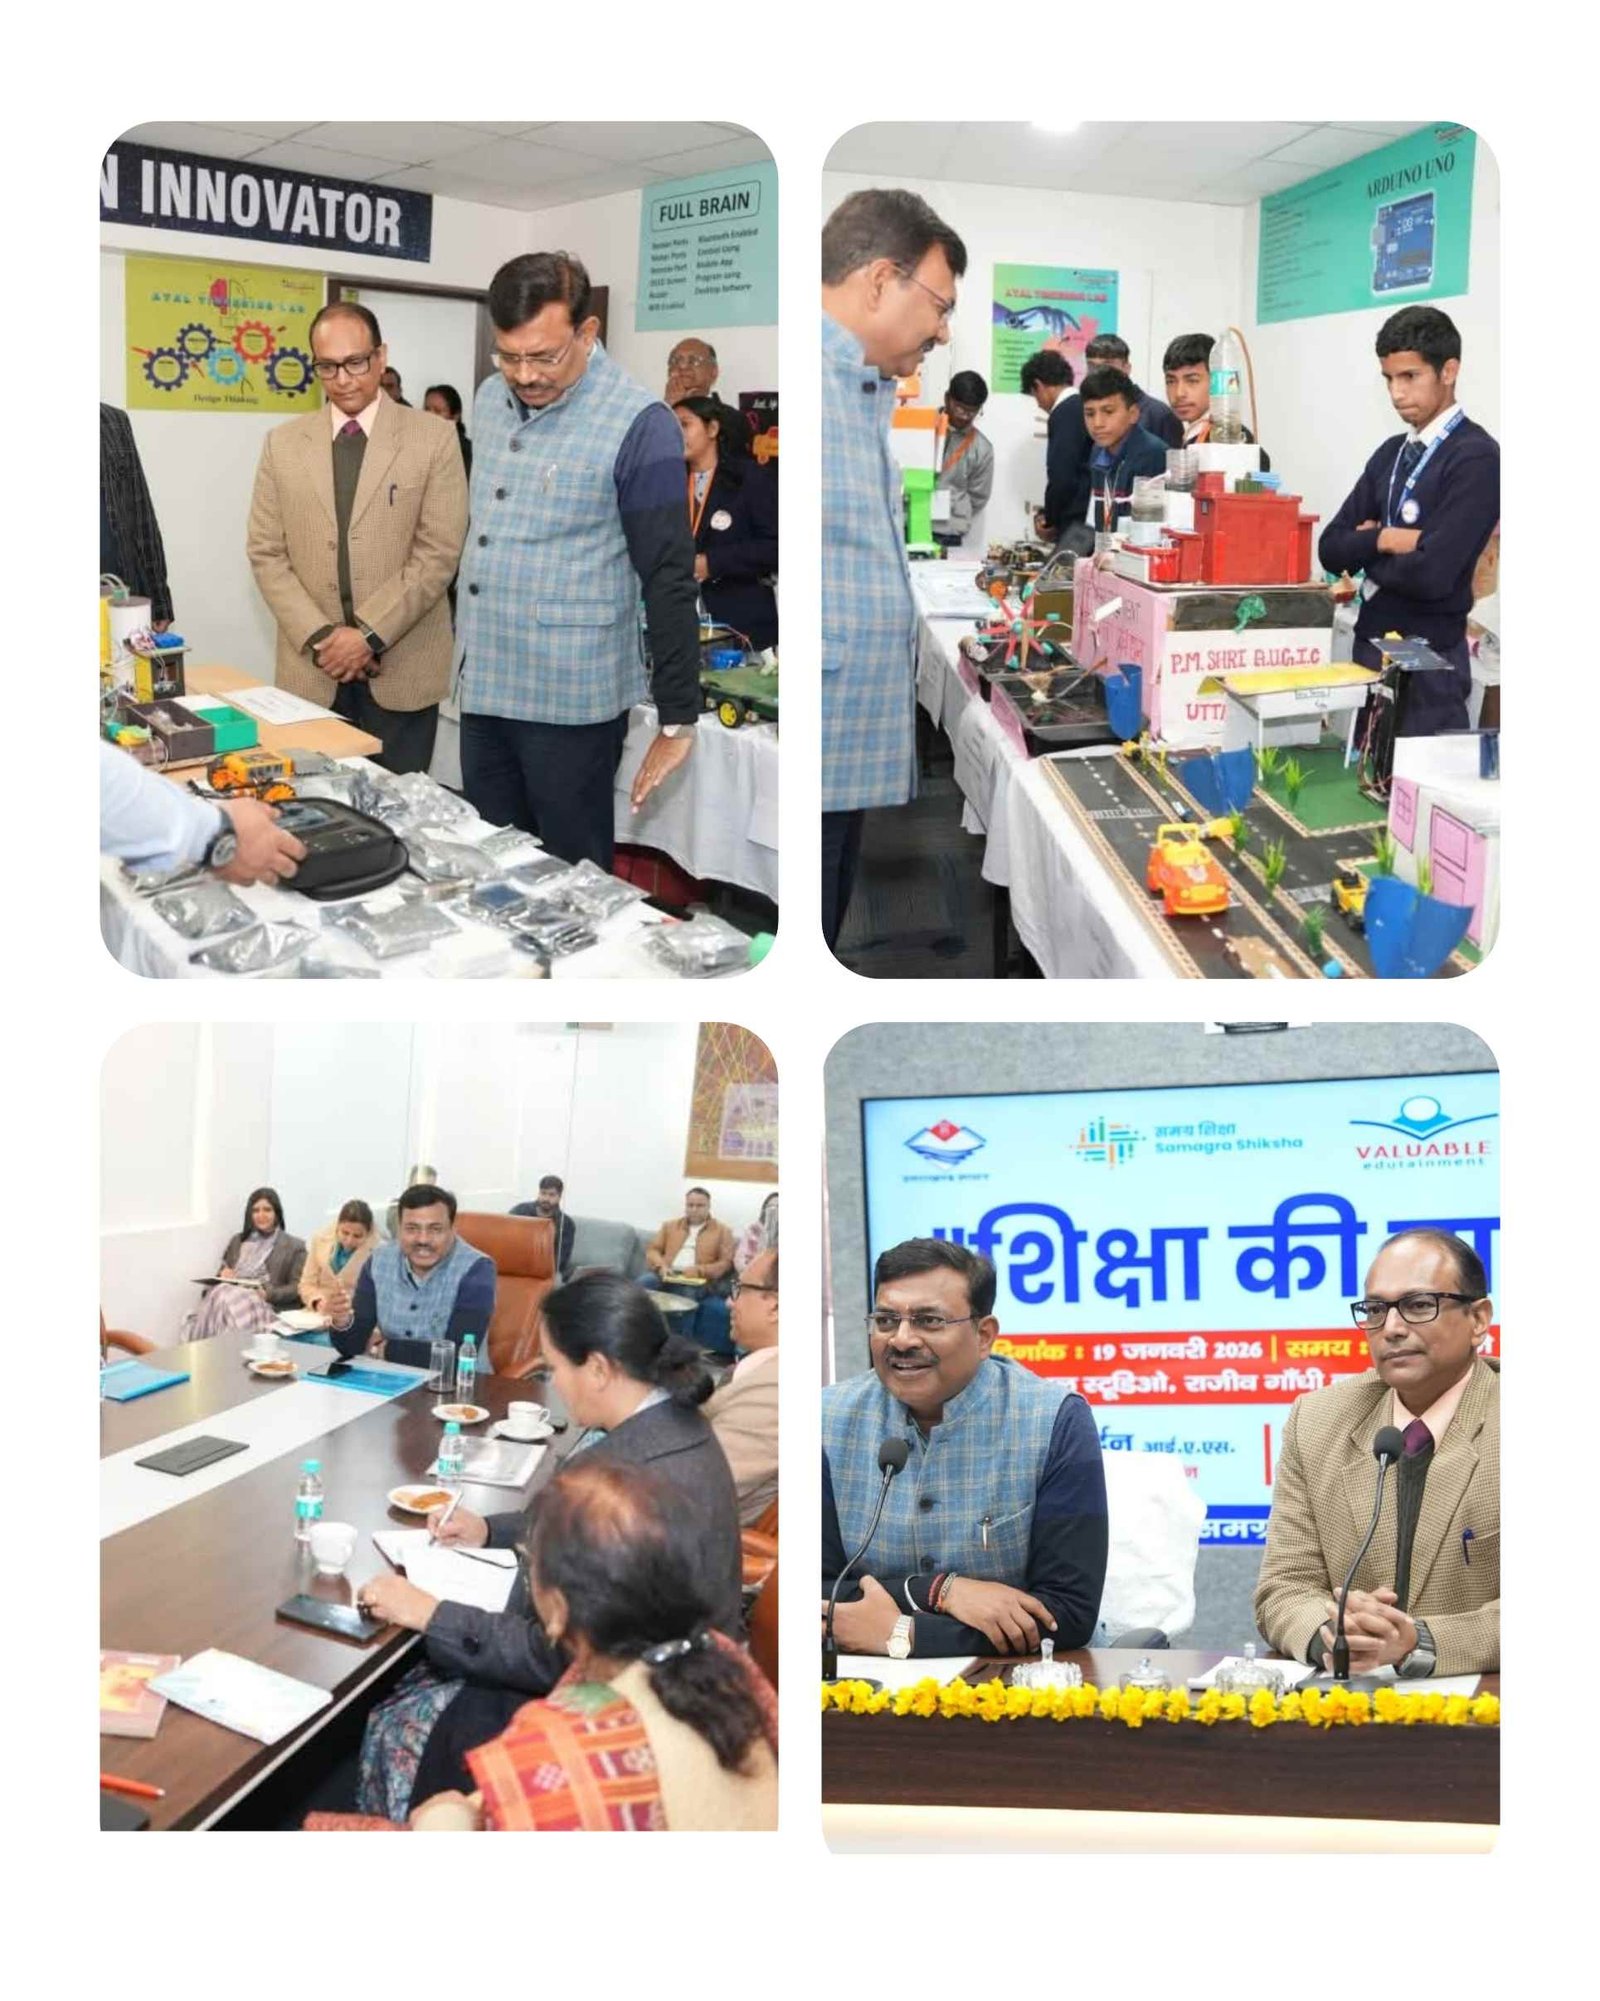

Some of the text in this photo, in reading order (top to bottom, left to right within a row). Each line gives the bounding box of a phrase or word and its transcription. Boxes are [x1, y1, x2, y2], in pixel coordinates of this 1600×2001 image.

[1365, 151, 1456, 199] ARDUINO UNO
[141, 159, 403, 248] INNOVATOR
[659, 190, 751, 223] FULL BRAIN
[1207, 649, 1247, 671] SHRI
[1155, 1137, 1304, 1154] Samagra Shiksha
[1357, 1141, 1494, 1160] VALUABLE
[1362, 1157, 1486, 1170] edutainment
[1228, 1193, 1368, 1299] की
[1093, 1344, 1116, 1360] 19
[1121, 1336, 1206, 1362] जनवरी
[1213, 1341, 1263, 1359] 2026
[1285, 1338, 1351, 1358] समय
[1183, 1368, 1259, 1392] राजीव
